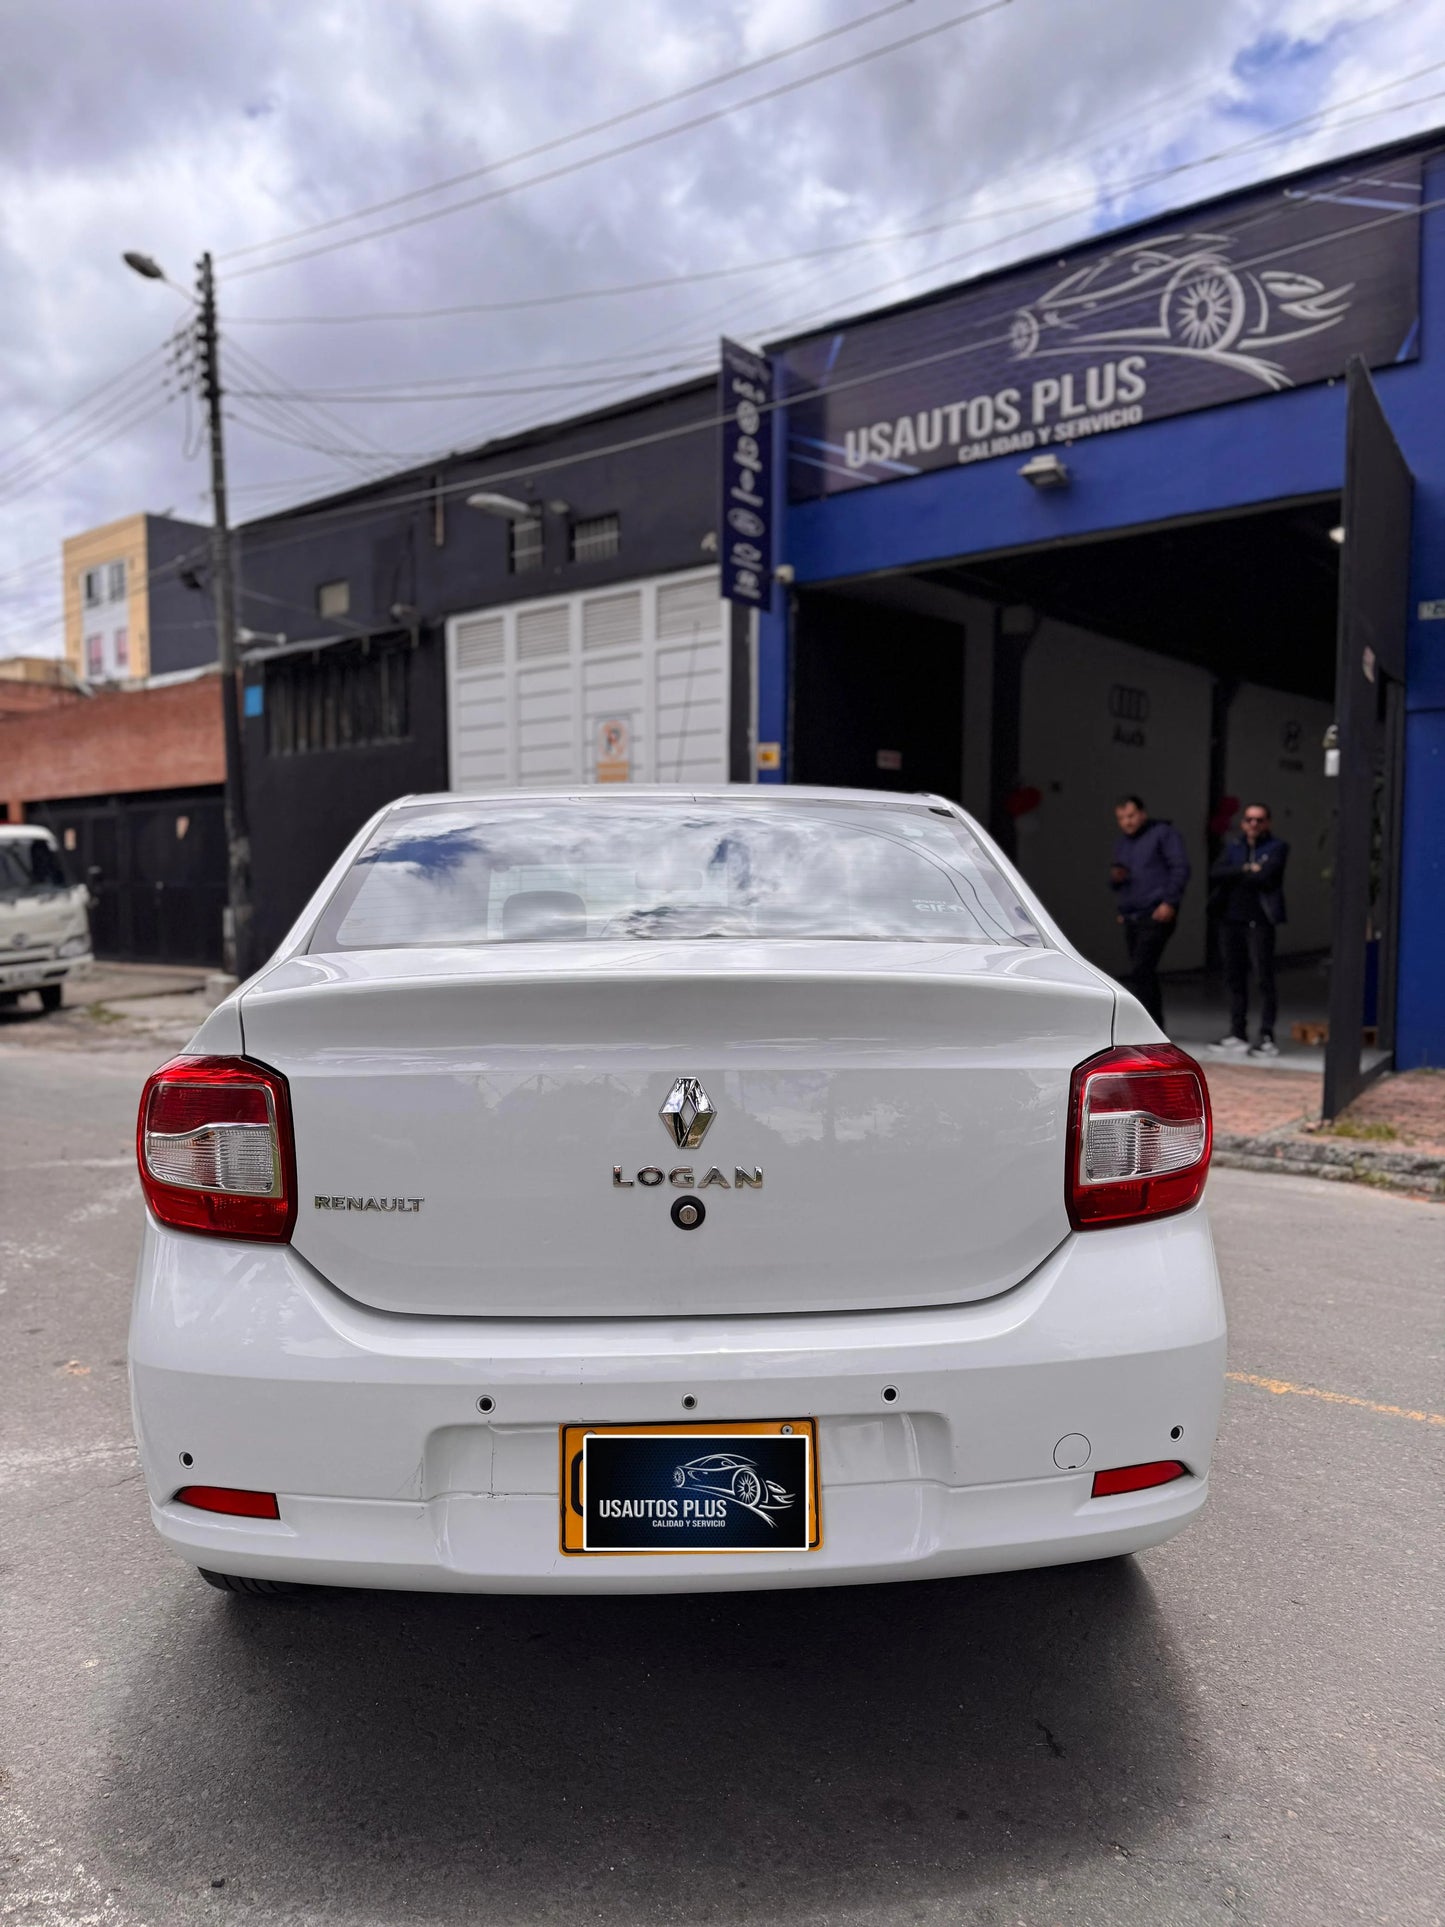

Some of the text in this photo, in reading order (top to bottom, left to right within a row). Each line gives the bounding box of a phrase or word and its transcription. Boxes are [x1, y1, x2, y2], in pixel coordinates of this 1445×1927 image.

[845, 355, 1147, 469] USAUTOS PLUS
[958, 405, 1143, 463] CALIDAD Y SERVICIO
[612, 1165, 764, 1189] LOGAN
[314, 1194, 425, 1213] RENAULT
